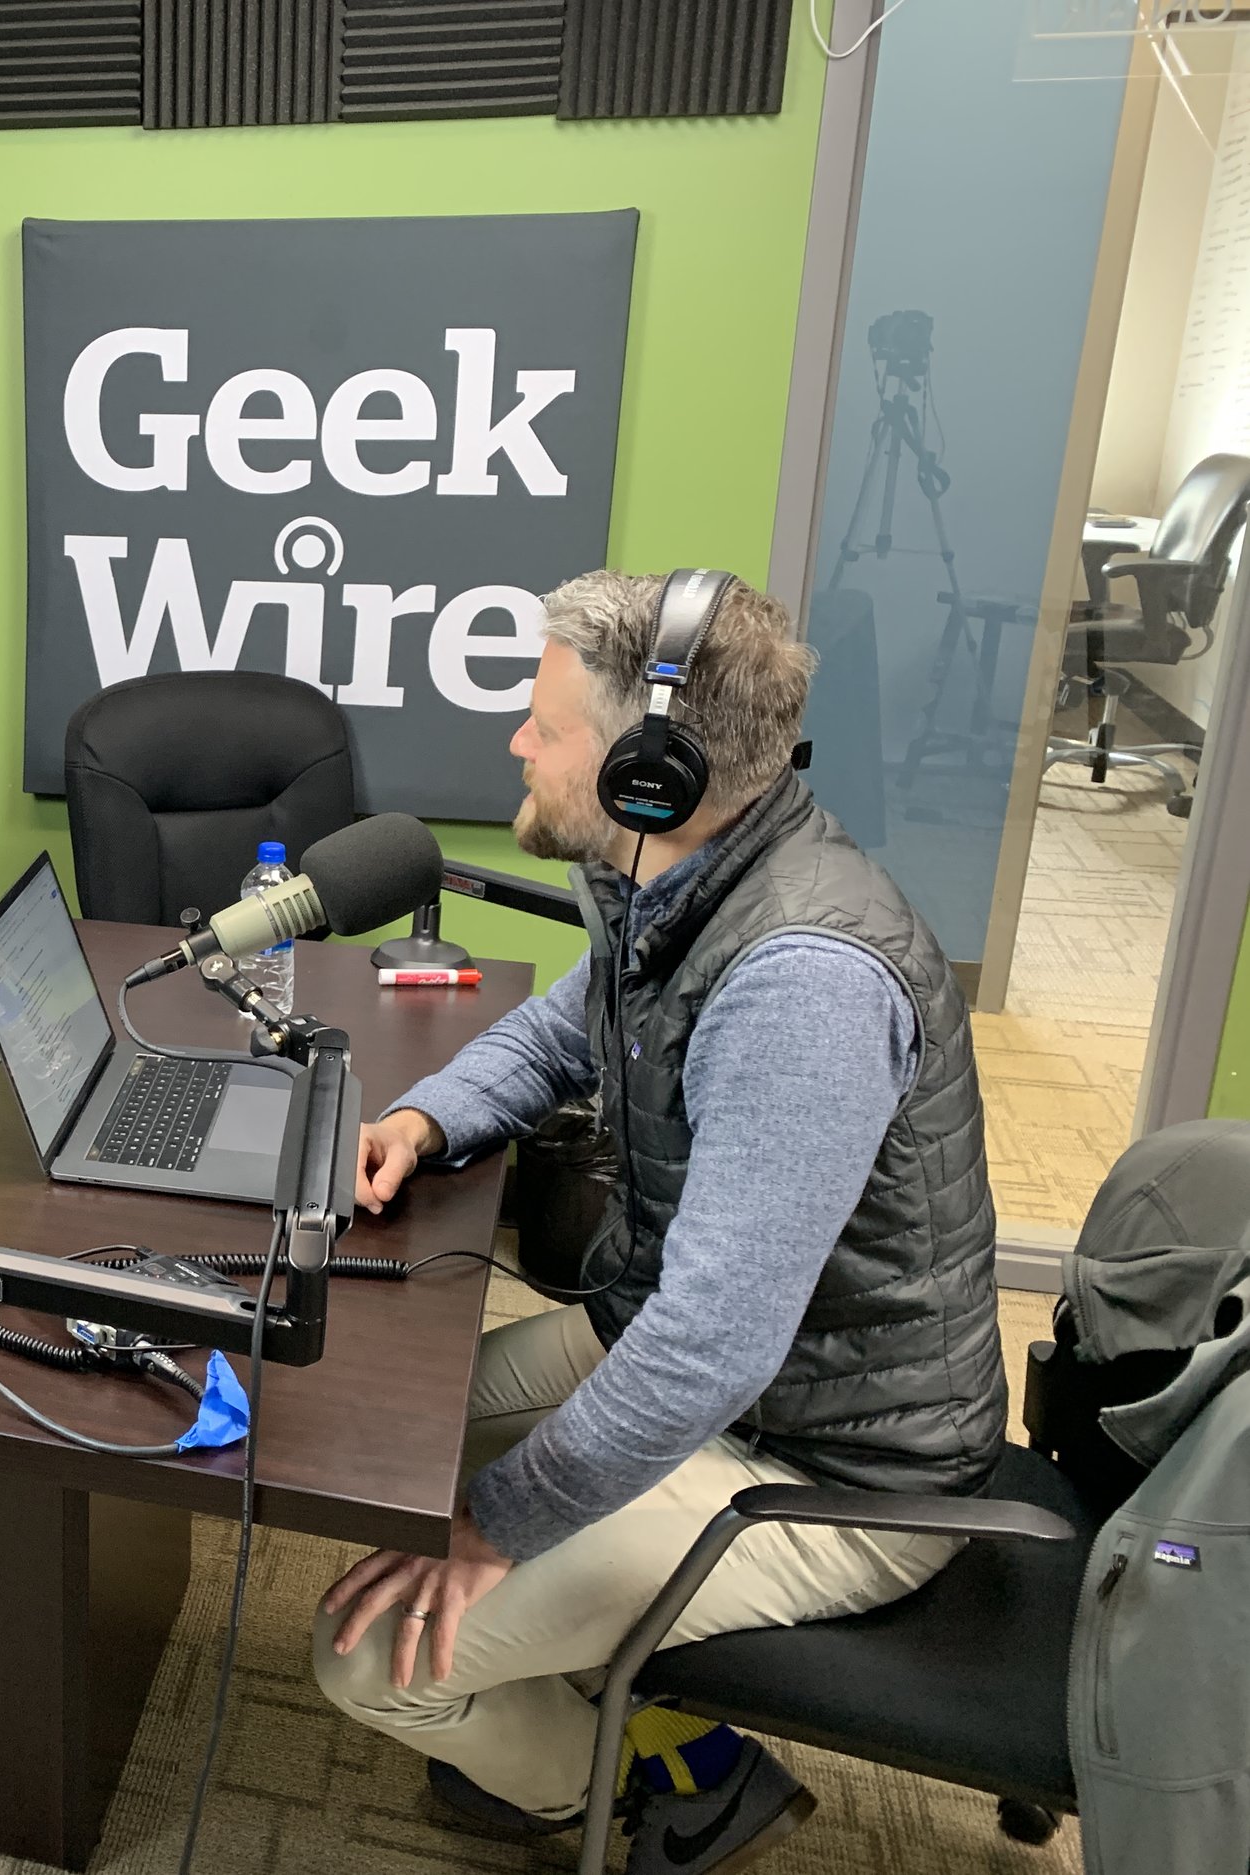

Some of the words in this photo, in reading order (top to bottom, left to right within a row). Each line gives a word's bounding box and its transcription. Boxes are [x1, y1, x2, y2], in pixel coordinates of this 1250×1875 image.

[63, 326, 577, 497] Geek
[63, 515, 547, 713] Wire
[631, 779, 663, 790] SONY
